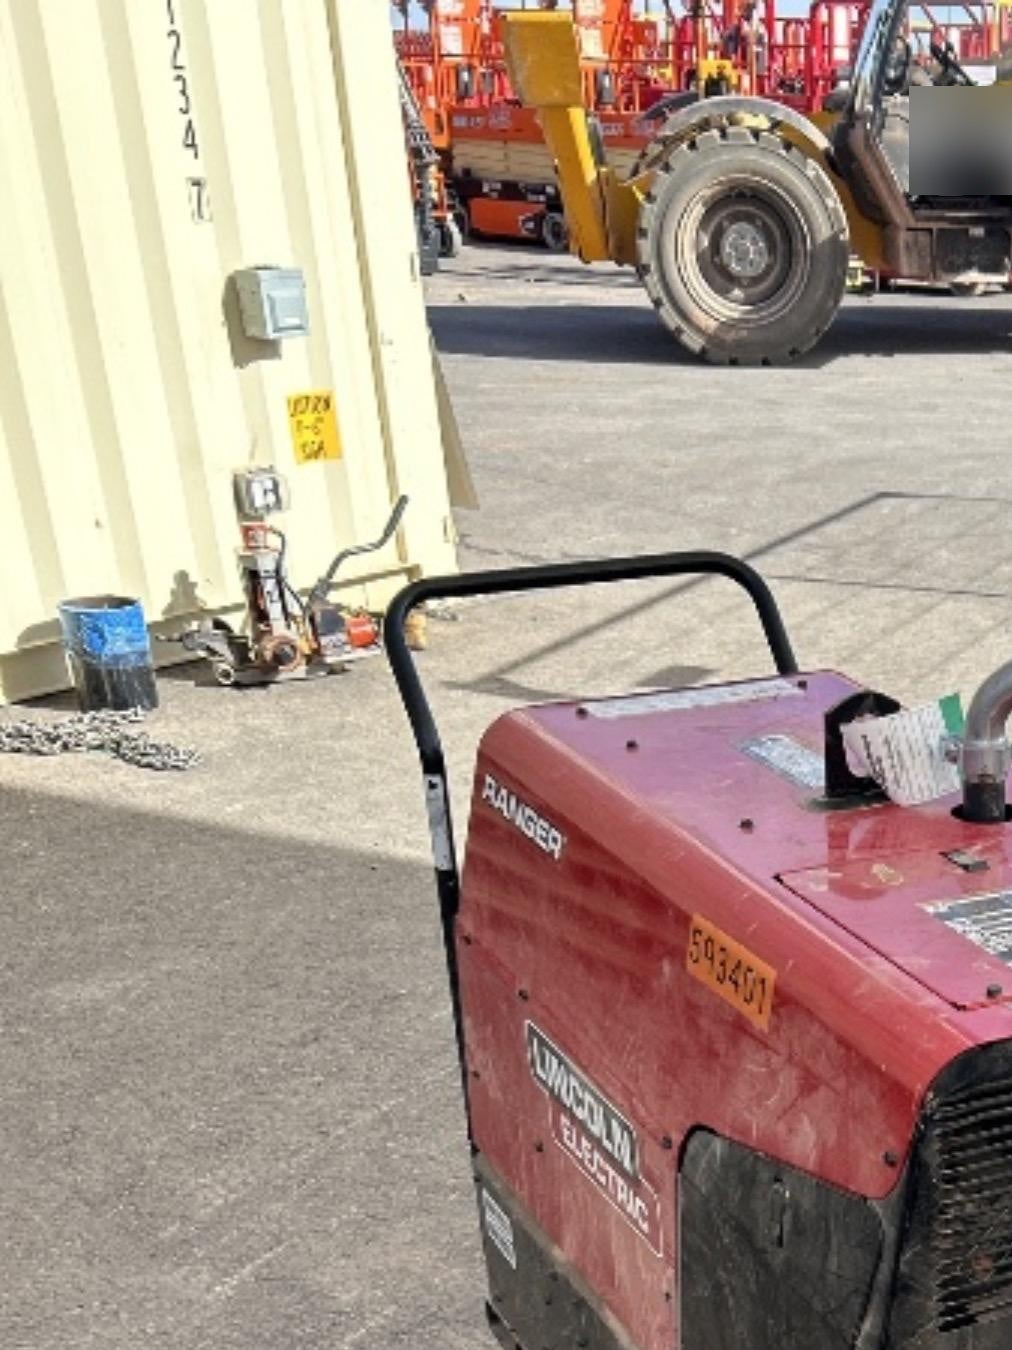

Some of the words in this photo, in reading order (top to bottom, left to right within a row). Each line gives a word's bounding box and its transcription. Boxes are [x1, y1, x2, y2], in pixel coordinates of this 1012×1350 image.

[482, 774, 562, 859] RANGER
[533, 1037, 634, 1173] LINCOLN
[559, 1112, 649, 1234] ELECTRIC
